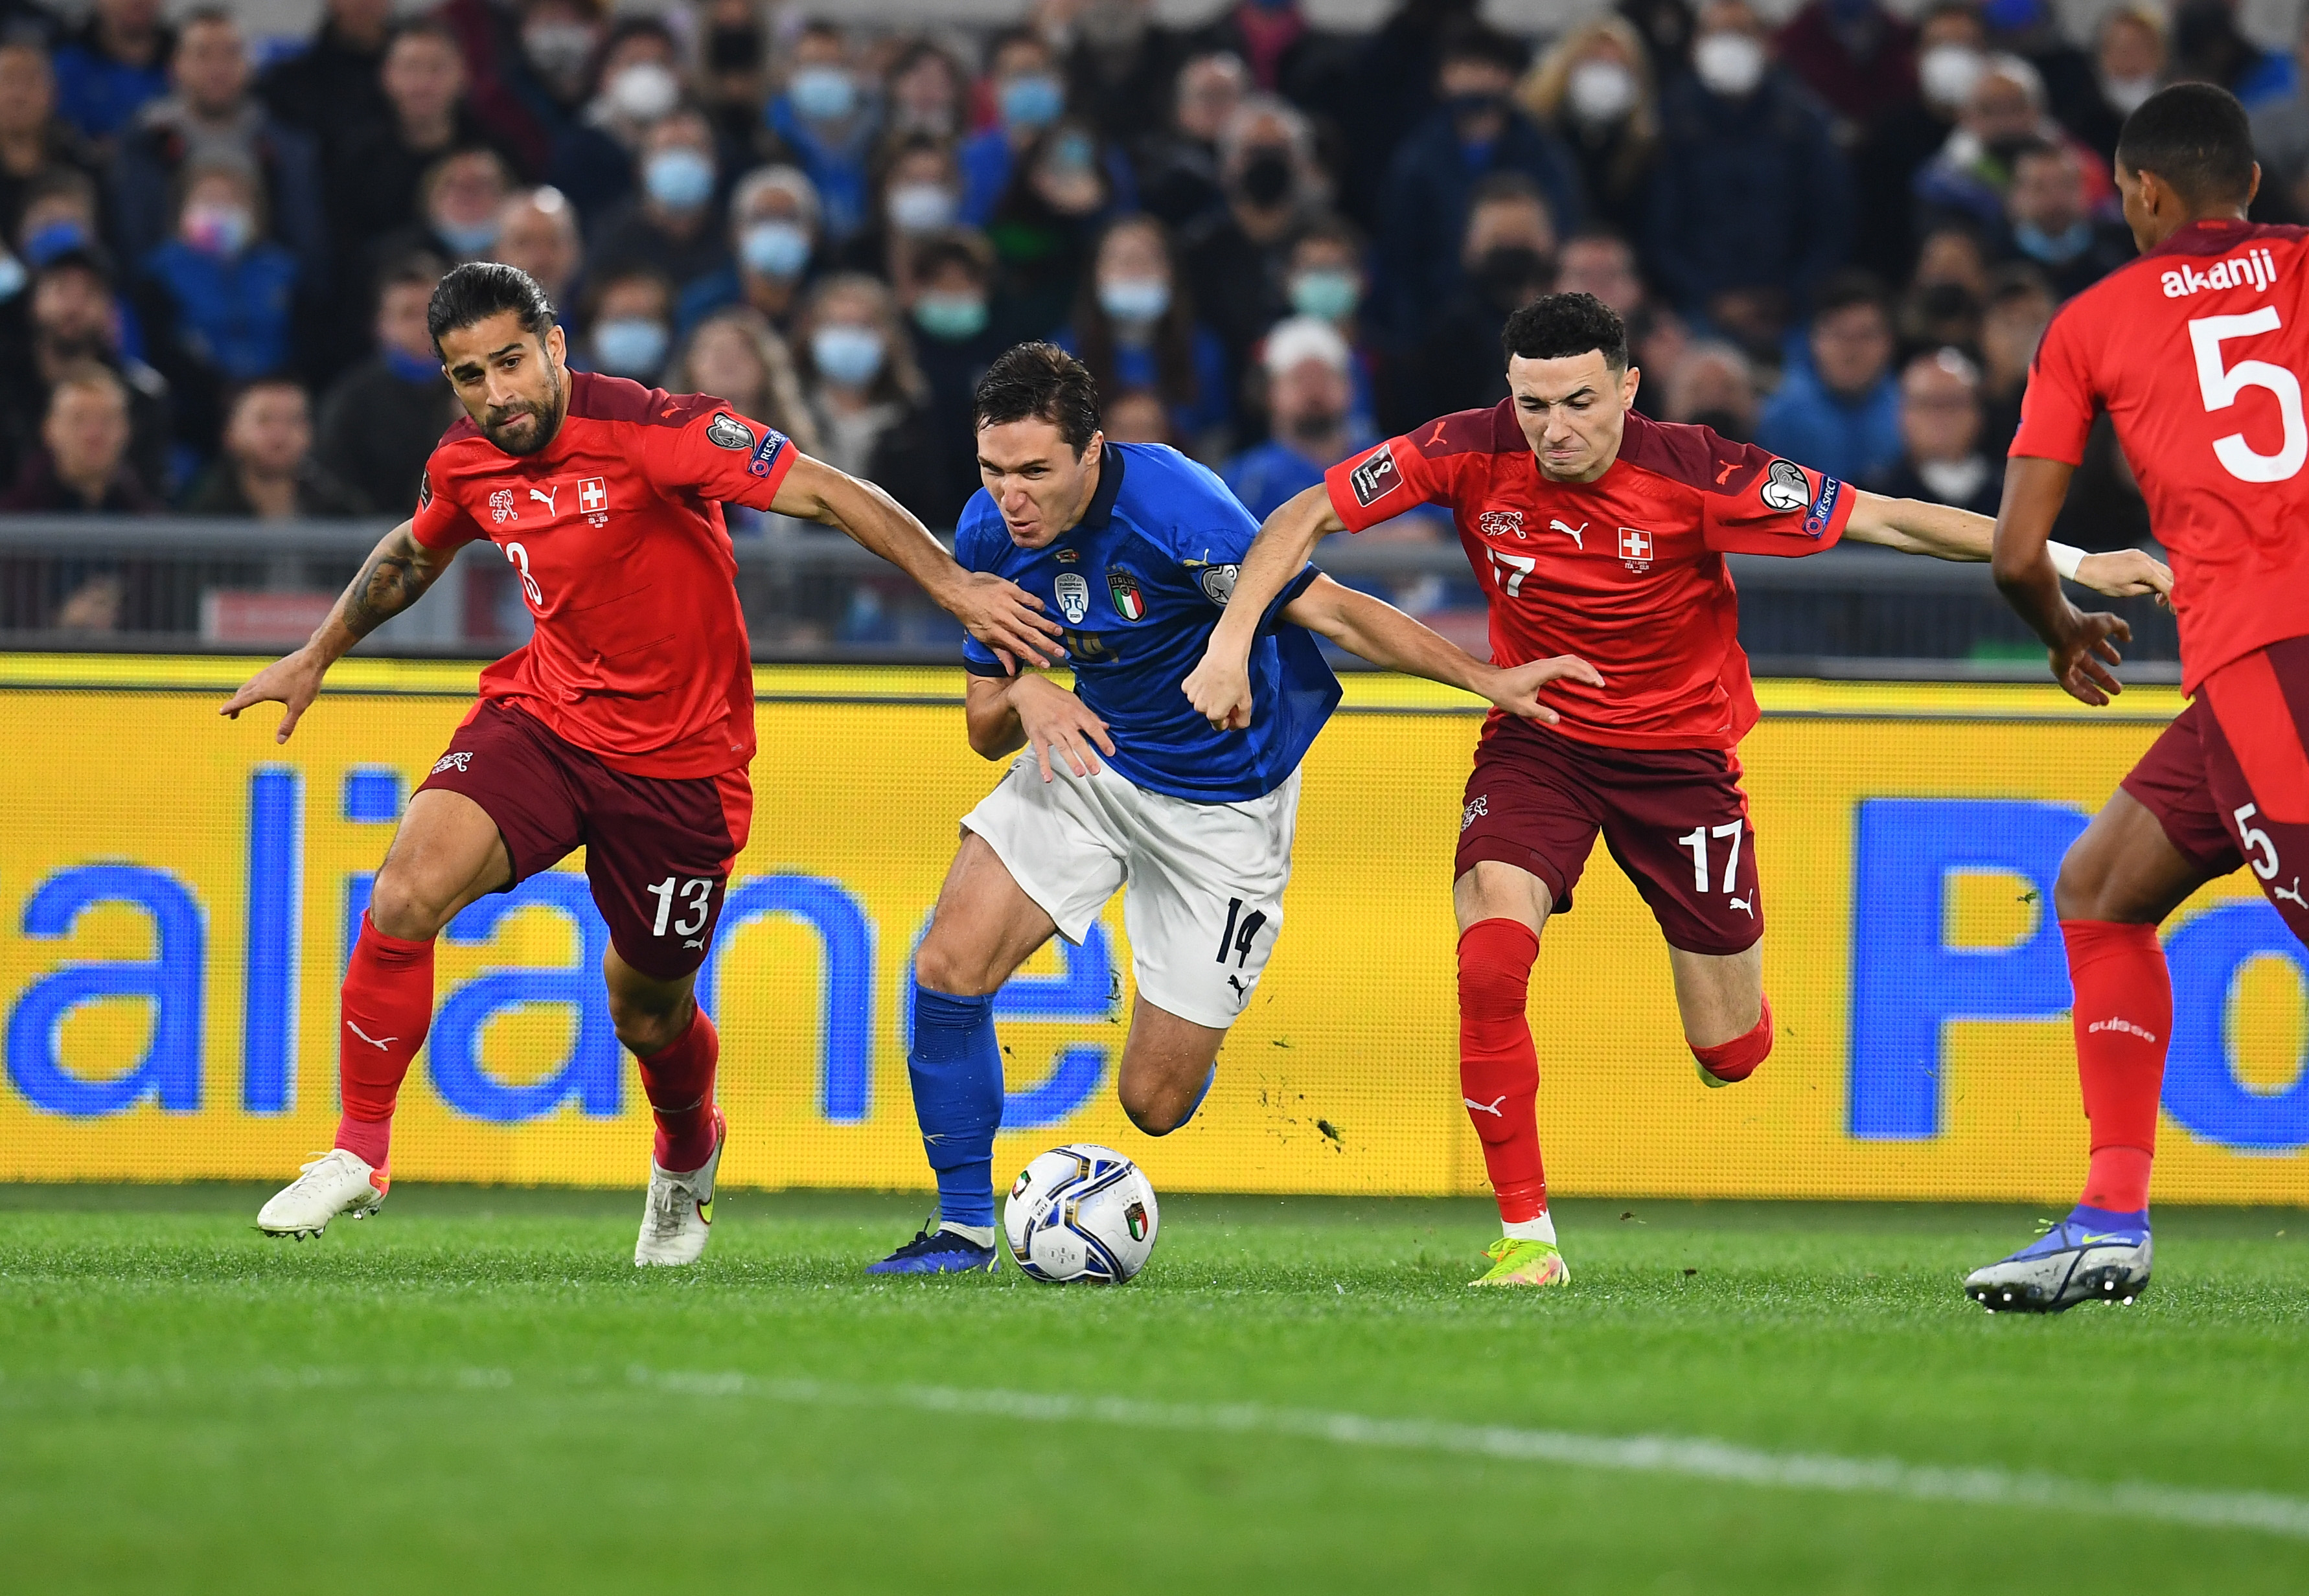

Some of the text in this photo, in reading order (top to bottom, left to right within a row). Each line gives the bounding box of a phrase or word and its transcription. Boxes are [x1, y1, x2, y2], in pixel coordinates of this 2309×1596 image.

[2160, 248, 2277, 298] akanji
[2188, 304, 2308, 483] 5
[1816, 476, 1837, 519] RESPECT
[496, 542, 542, 606] 3
[1485, 545, 1536, 598] 17
[1679, 818, 1743, 894] 17
[2233, 802, 2280, 880] 5
[647, 876, 713, 937] 13
[1215, 896, 1267, 969] 14
[2088, 1016, 2156, 1043] suisse
